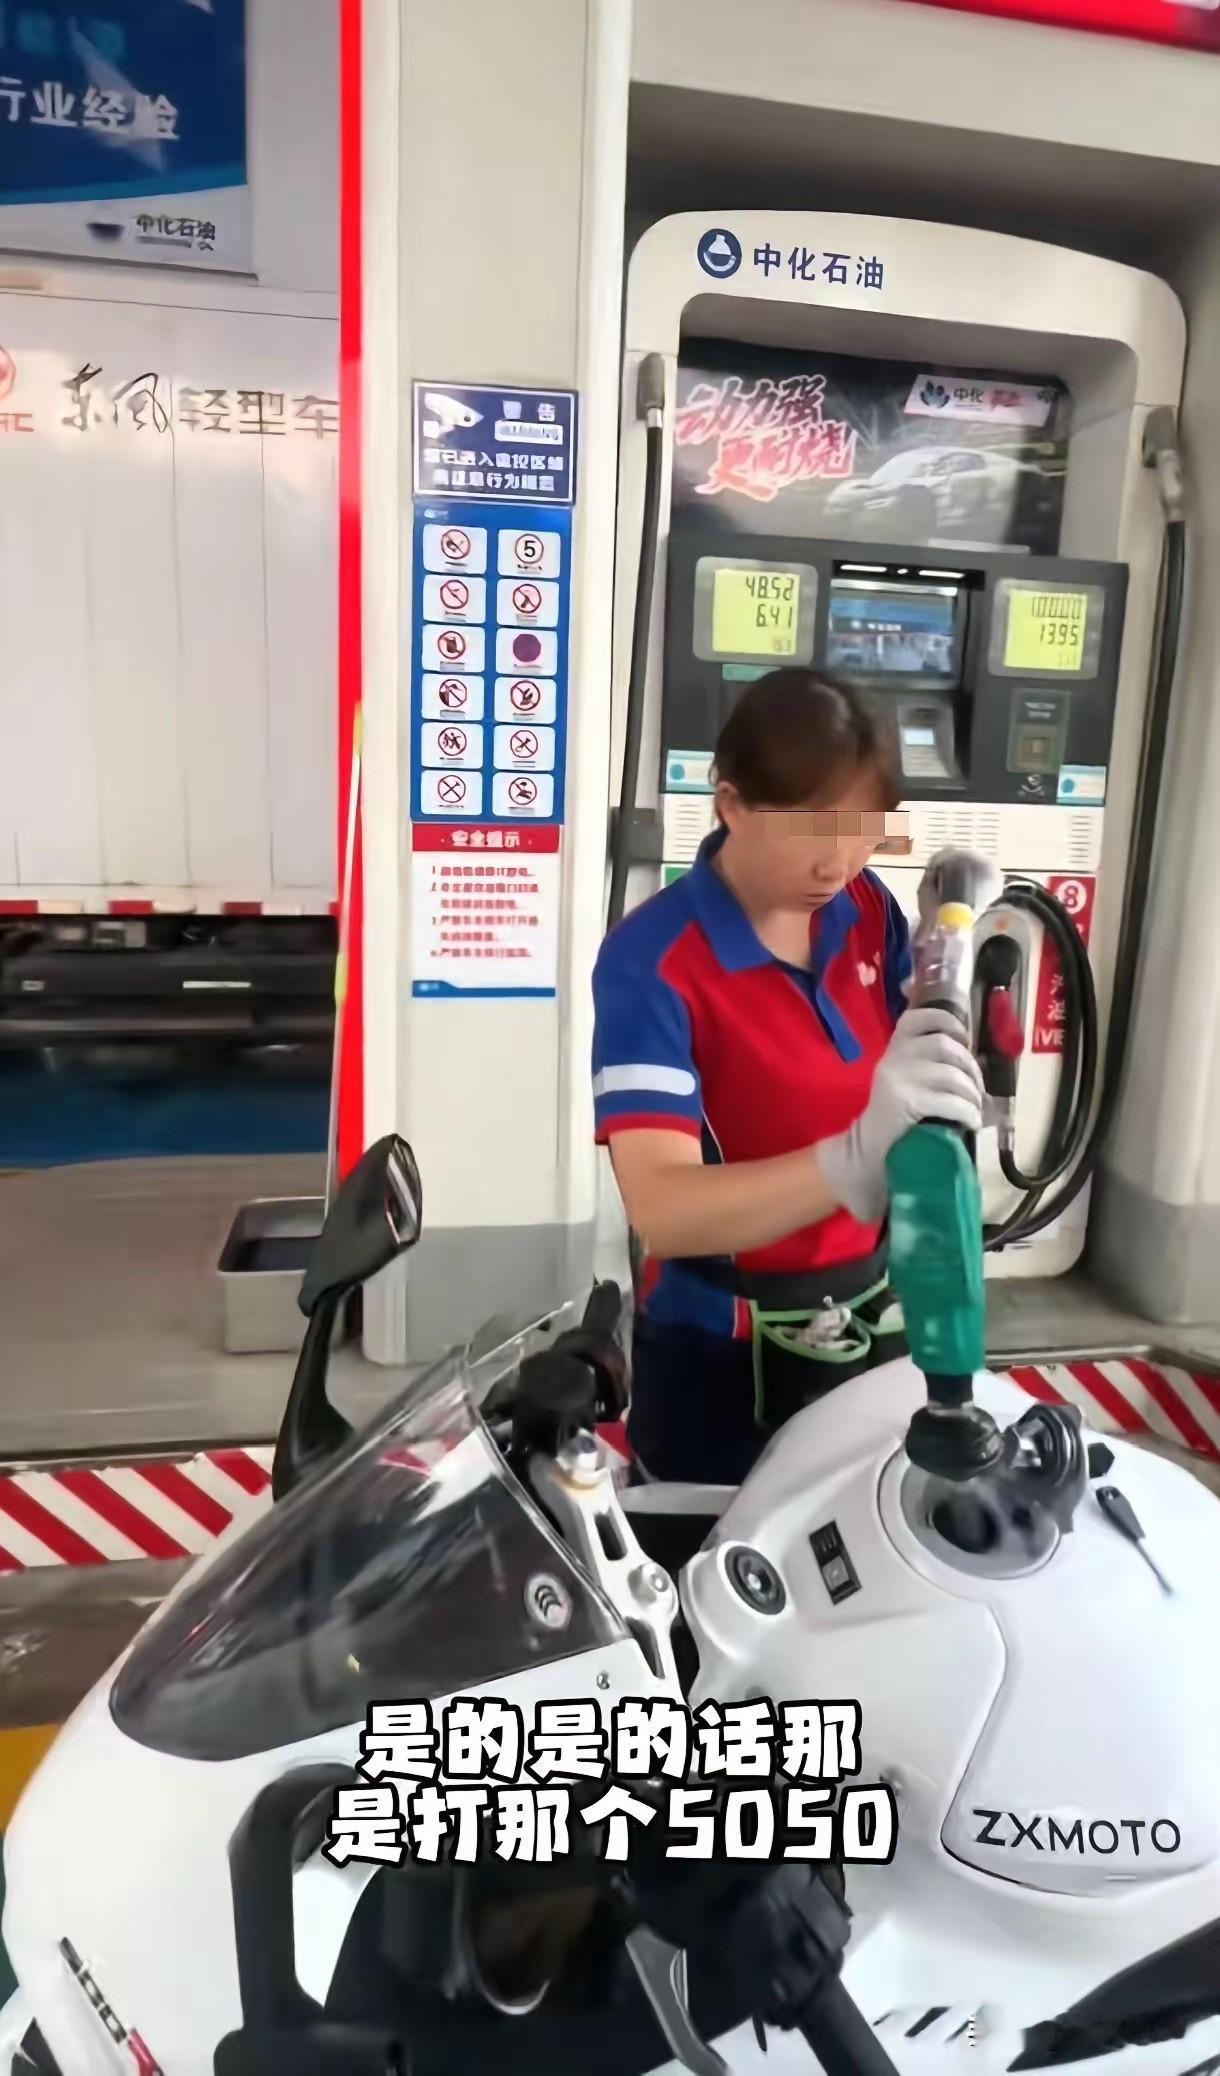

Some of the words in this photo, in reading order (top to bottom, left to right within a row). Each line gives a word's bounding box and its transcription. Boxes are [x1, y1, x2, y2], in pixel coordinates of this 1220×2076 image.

[753, 243, 884, 289] 中化石油
[674, 374, 827, 446] 动力强
[524, 540, 537, 558] 5
[973, 1809, 1181, 1856] ZXMOTO
